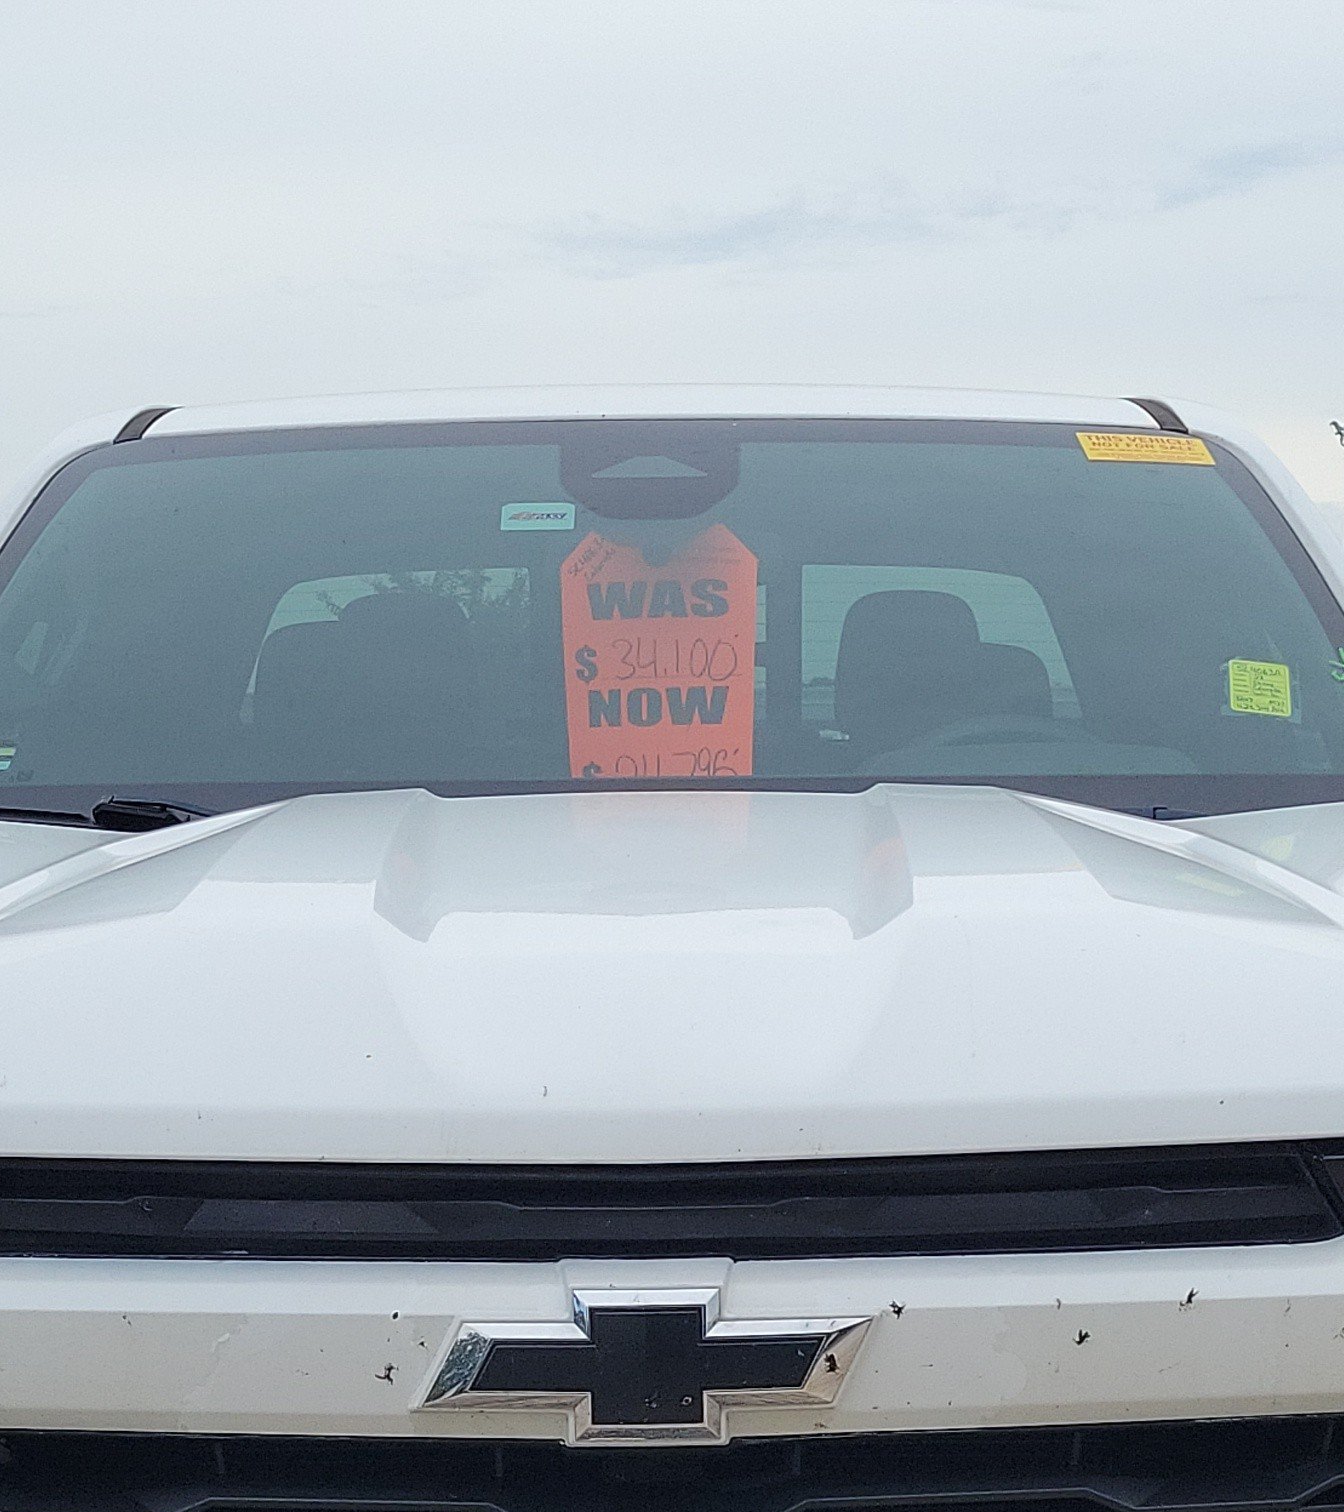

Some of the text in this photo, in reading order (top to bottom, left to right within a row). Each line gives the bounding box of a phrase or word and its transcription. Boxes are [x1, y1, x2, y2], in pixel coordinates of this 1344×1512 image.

[1126, 436, 1195, 446] VEHICLE
[1158, 443, 1194, 452] SALE
[587, 578, 729, 621] WAS
[574, 644, 599, 684] $
[588, 685, 729, 728] NOW
